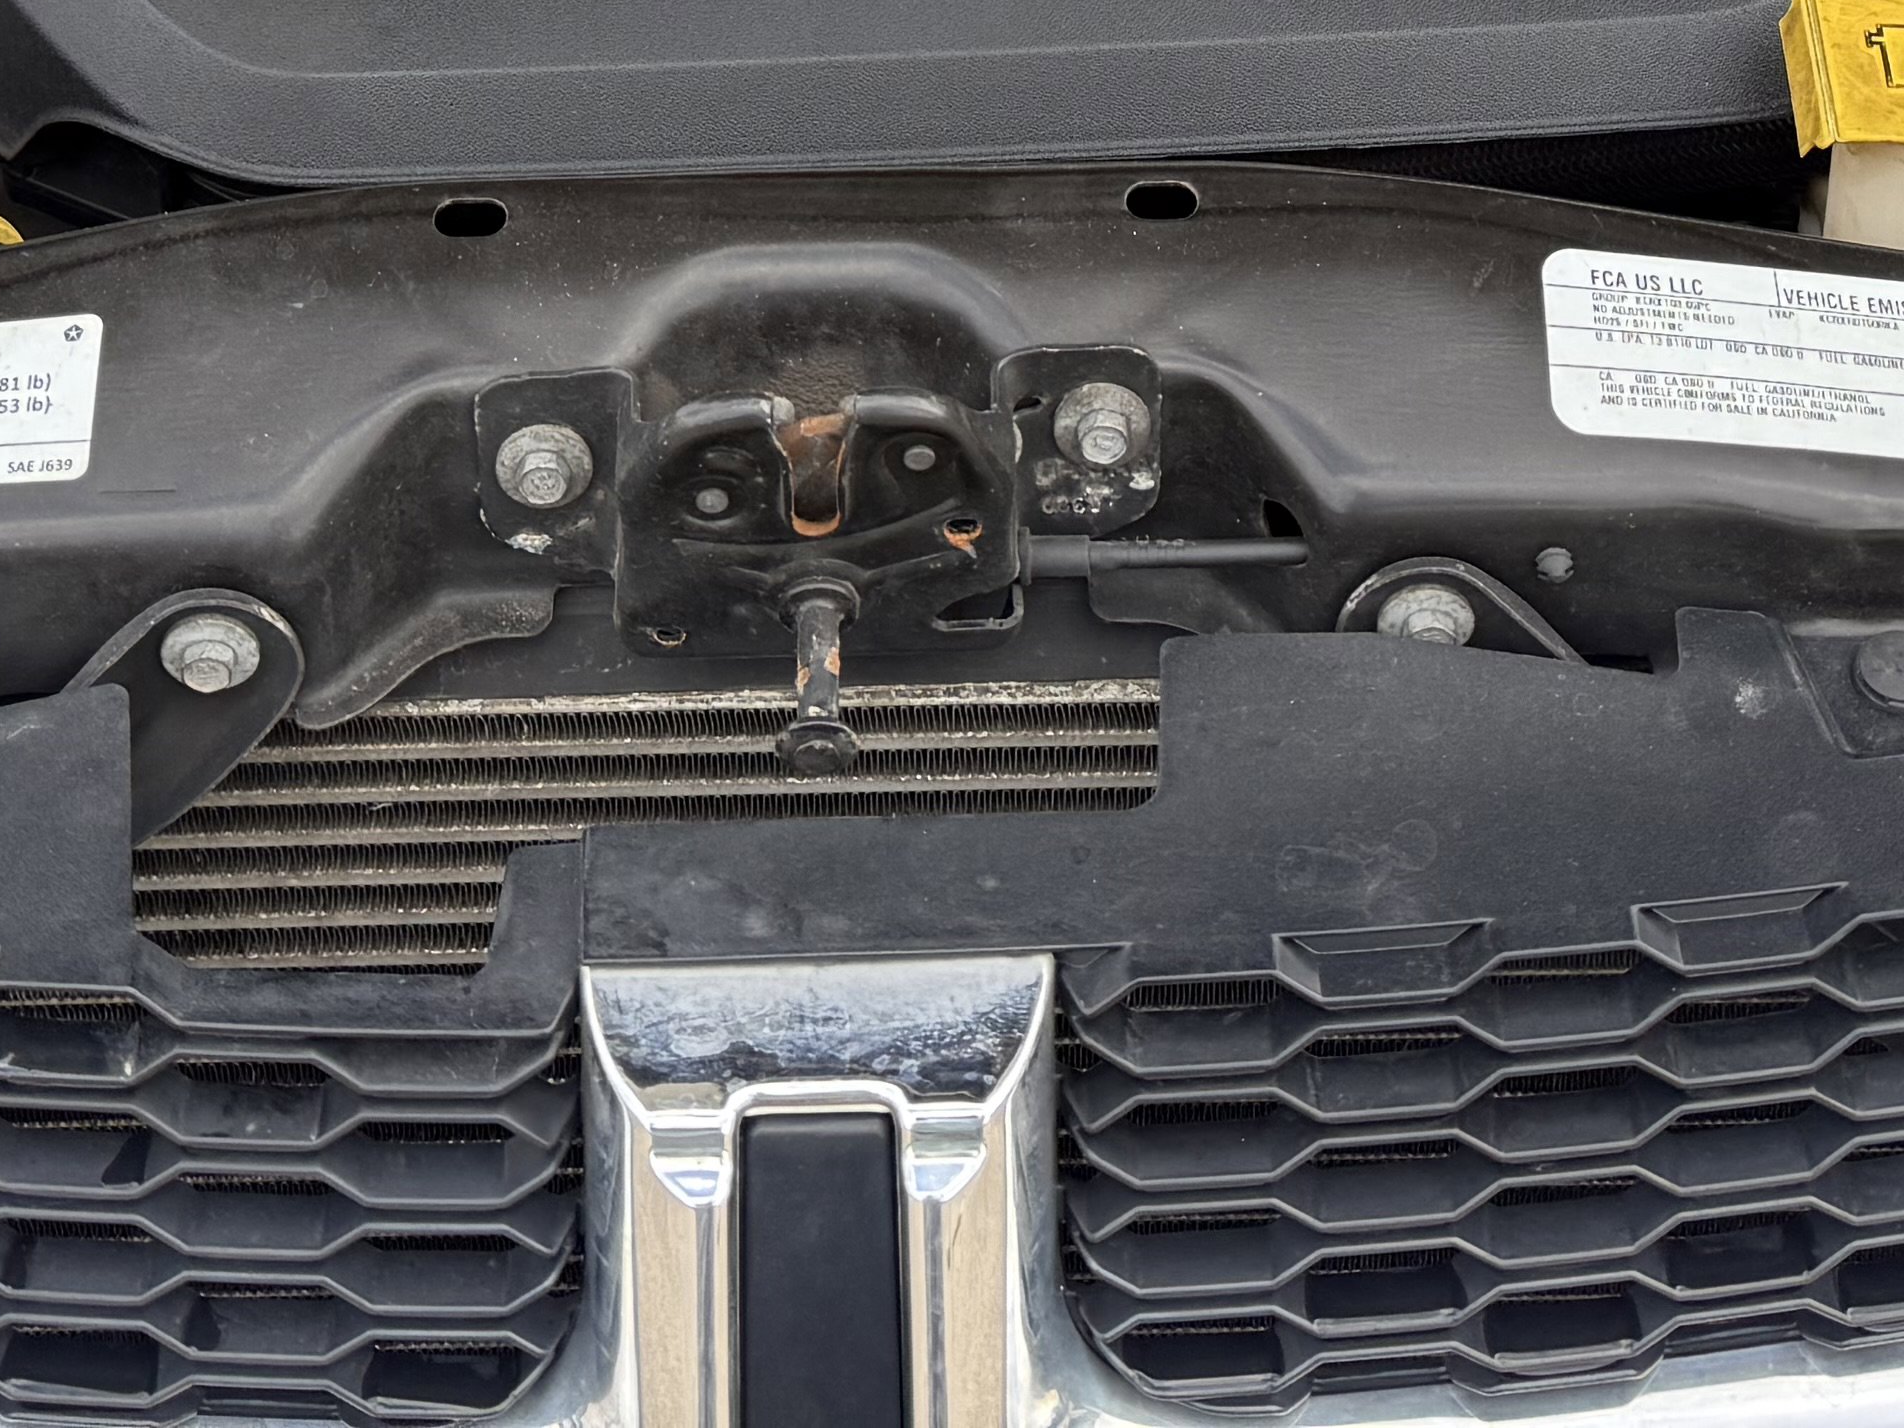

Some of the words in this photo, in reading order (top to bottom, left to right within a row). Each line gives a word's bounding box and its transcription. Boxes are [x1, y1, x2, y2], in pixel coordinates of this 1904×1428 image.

[1590, 270, 1627, 290] FCA
[1635, 273, 1661, 292] US
[1668, 276, 1704, 296] LLC
[1783, 288, 1860, 312] VEHICLE
[26, 373, 52, 391] lb)
[26, 396, 53, 414] lb)
[7, 460, 35, 474] SAE
[38, 458, 74, 473] J639
